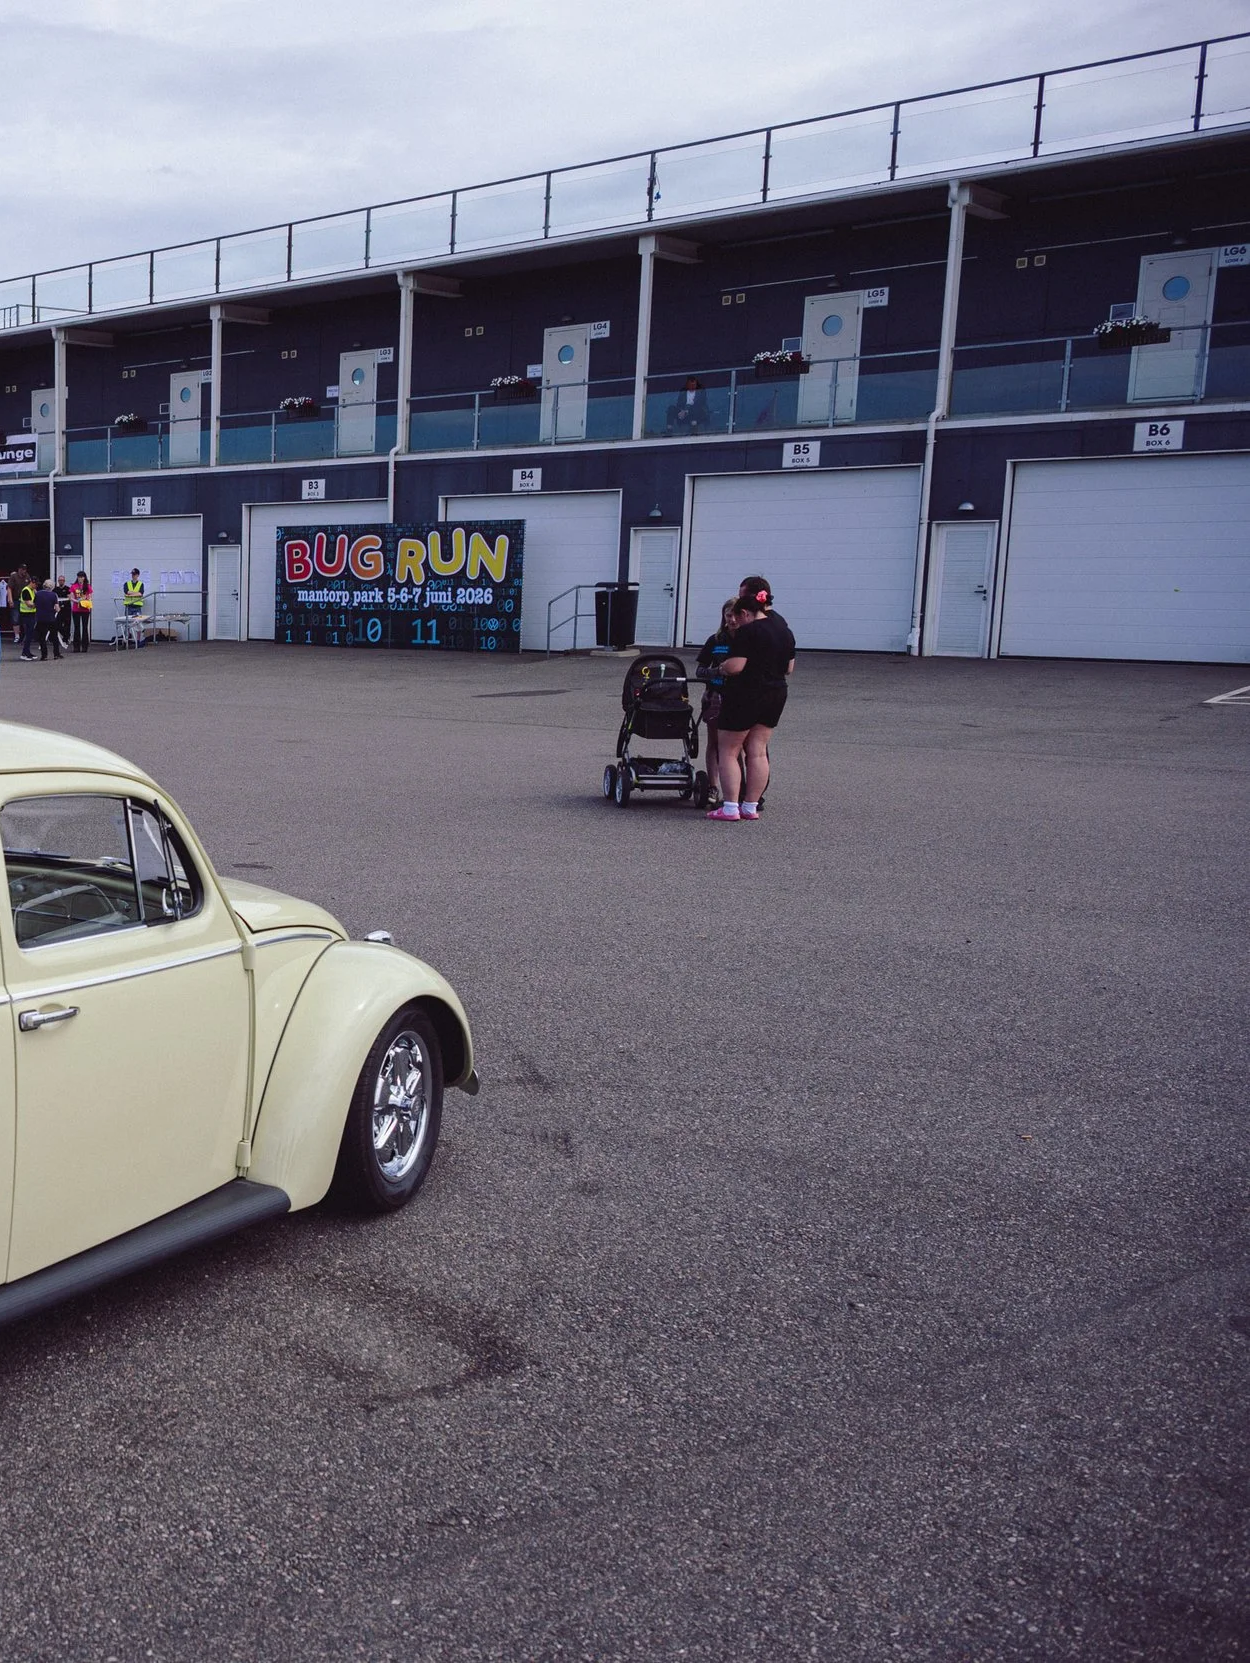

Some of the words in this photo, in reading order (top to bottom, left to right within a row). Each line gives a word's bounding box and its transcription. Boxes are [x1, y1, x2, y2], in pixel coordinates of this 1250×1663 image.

[1224, 246, 1247, 256] LG6
[867, 289, 885, 298] LG5
[593, 322, 607, 330] LG4
[1148, 423, 1171, 437] B6
[793, 443, 810, 455] B5
[520, 470, 534, 480] B4
[308, 481, 319, 490] B3
[137, 498, 146, 506] B2
[284, 532, 385, 583] BUG
[395, 527, 510, 585] RUN
[297, 587, 350, 606] mantorp
[352, 587, 384, 606] park
[387, 587, 422, 604] 5-6-7
[423, 587, 453, 608] juni
[456, 587, 493, 605] 2026
